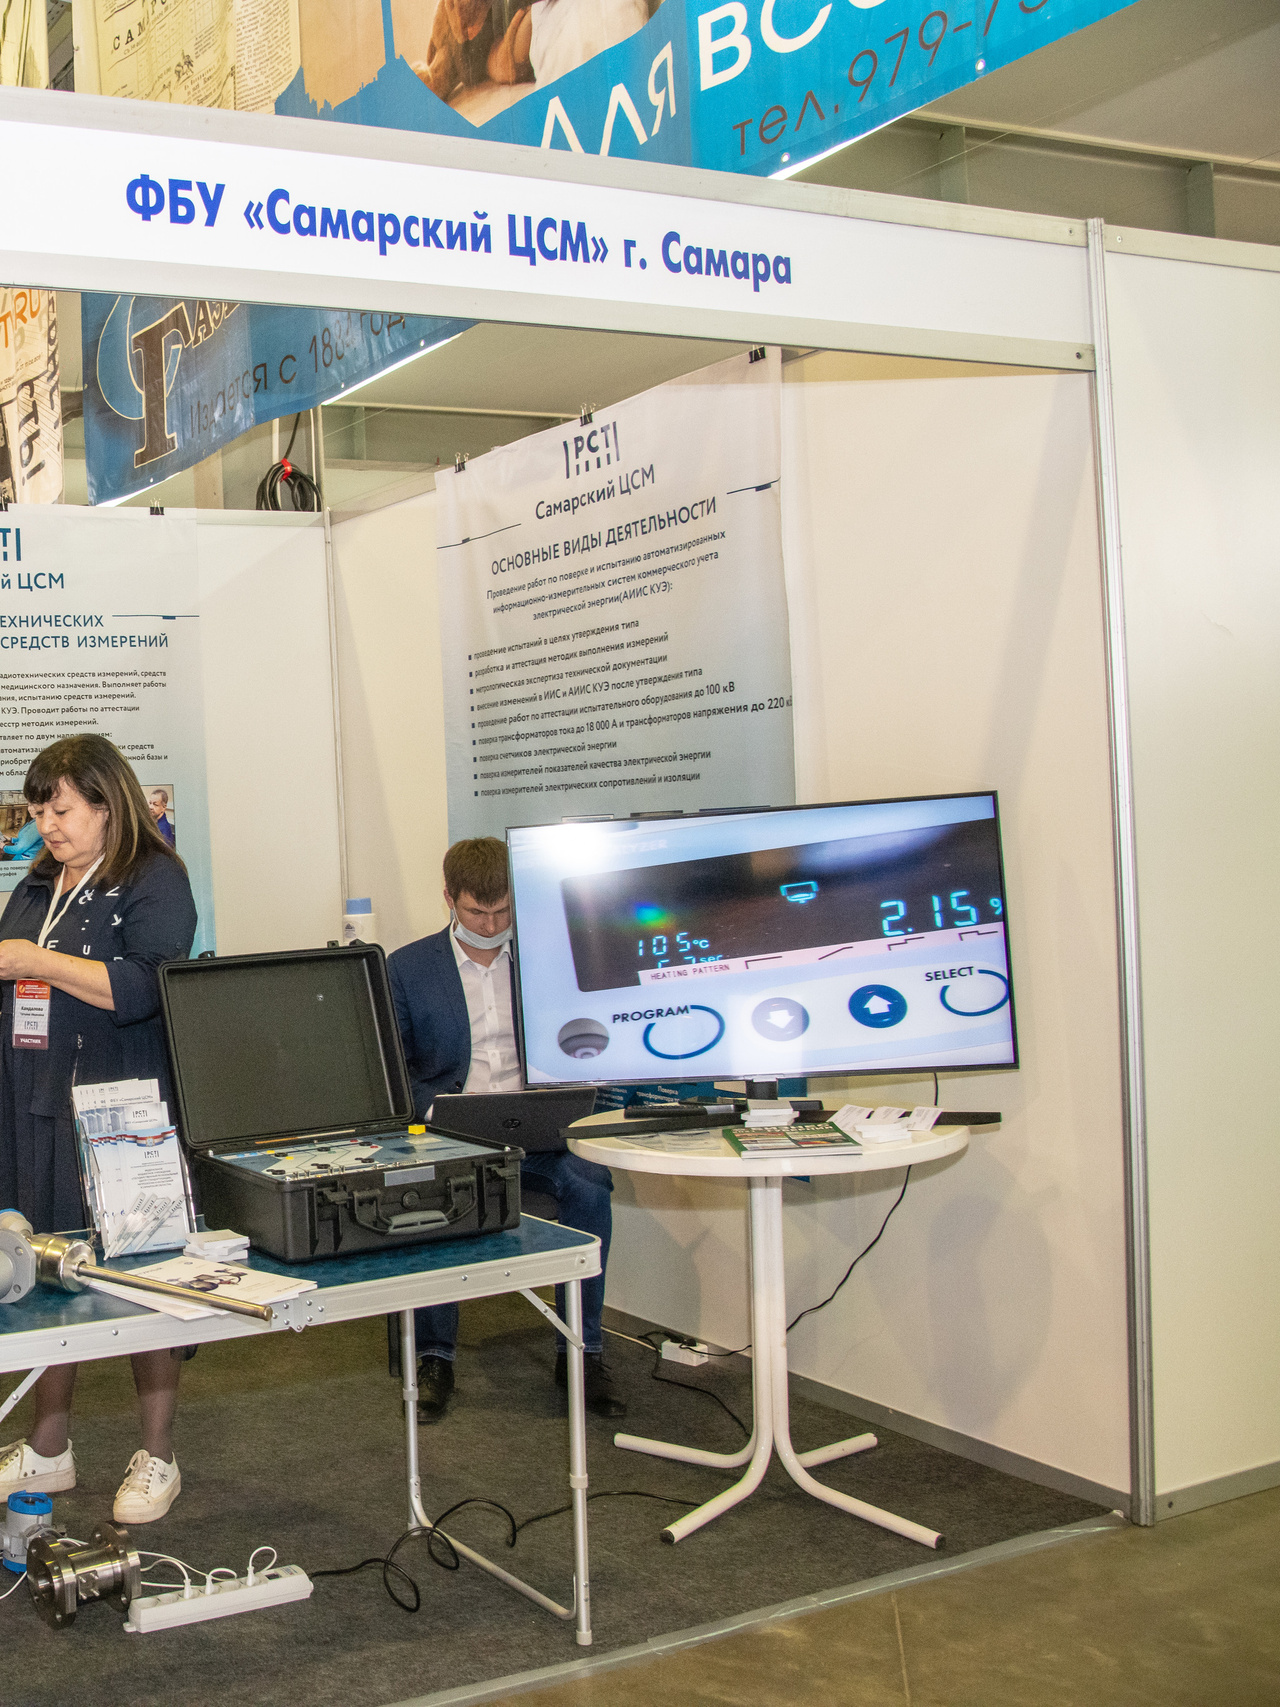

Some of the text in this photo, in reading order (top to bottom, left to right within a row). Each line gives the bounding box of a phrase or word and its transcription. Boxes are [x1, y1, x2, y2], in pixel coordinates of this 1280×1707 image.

[733, 89, 839, 156] тел.
[126, 173, 792, 292] ФБУ «Самарский ЦСМ» г. Самара
[573, 424, 610, 459] РСТ
[535, 464, 655, 520] Самарский ЦСМ
[491, 498, 716, 575] ОСНОВНЫЕ ВИДЫ ДЕЯТЕЛЬНОСТИ
[487, 584, 526, 600] Проведение
[527, 578, 547, 592] работ
[548, 576, 558, 584] по
[559, 568, 589, 581] поверке
[596, 555, 642, 572] испытанию
[643, 531, 726, 561] автоматизированных
[18, 572, 63, 592] ЦСМ
[0, 635, 70, 651] СРЕДСТВ
[77, 633, 168, 648] ИЗМЕРЕНИЙ
[97, 669, 140, 678] измерений,
[0, 683, 56, 691] медицинского
[142, 680, 167, 689] работы
[94, 691, 136, 700] измерений.
[20, 706, 60, 715] Проводит
[61, 705, 88, 714] работы
[55, 718, 99, 727] измерений.
[25, 733, 34, 741] по
[36, 731, 56, 742] двум
[650, 969, 688, 981] HEATING
[693, 963, 730, 975] PATTERN
[925, 966, 974, 982] SELECT
[612, 1005, 690, 1023] PROGRAM
